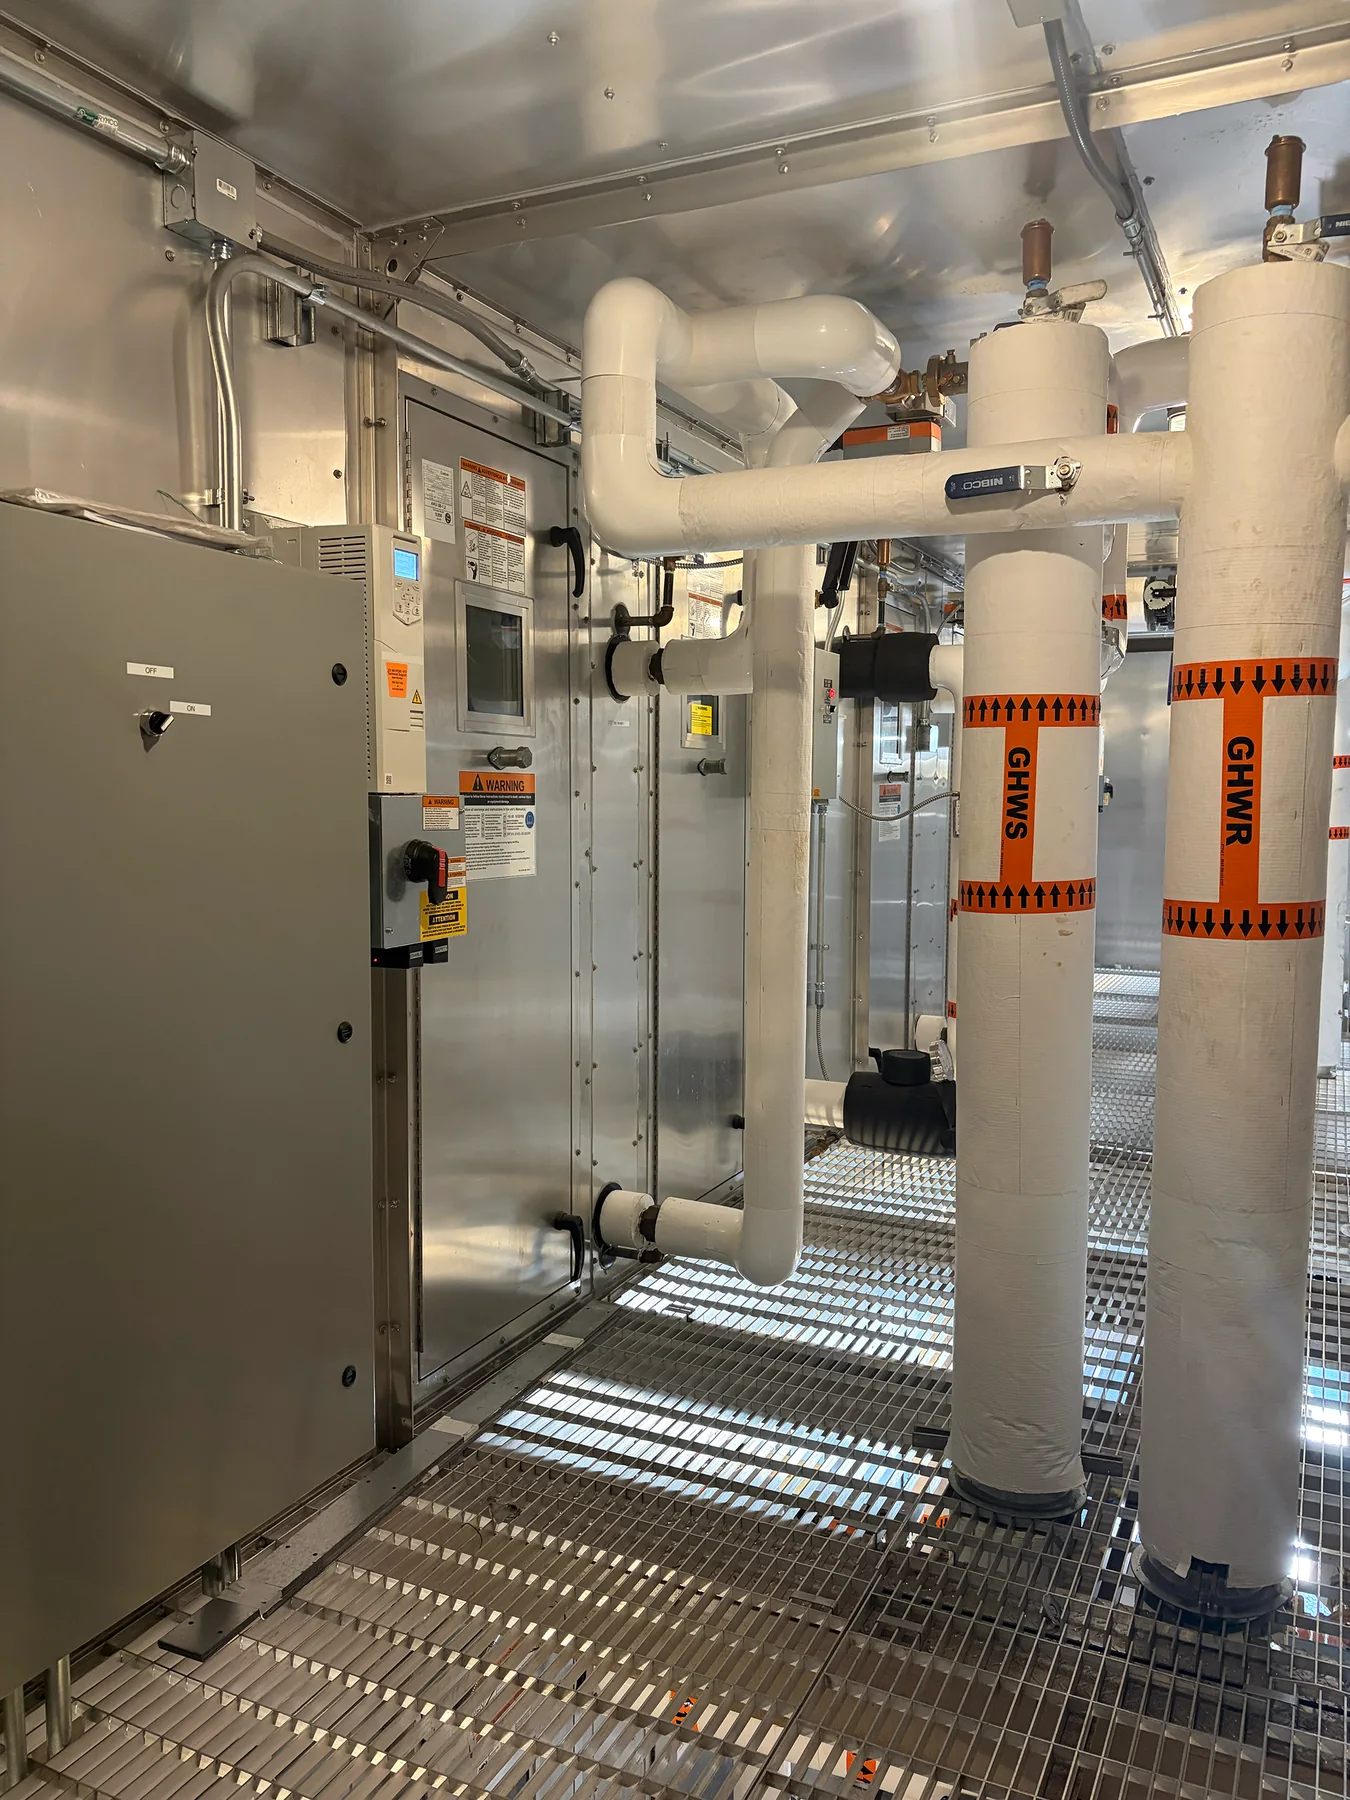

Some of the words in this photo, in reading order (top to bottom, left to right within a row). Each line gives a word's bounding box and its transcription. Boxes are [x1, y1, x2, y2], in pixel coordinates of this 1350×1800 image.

[963, 477, 1003, 490] NIBCO
[144, 666, 157, 674] OFF
[186, 704, 196, 712] ON
[486, 779, 525, 792] WARNING
[1225, 736, 1255, 846] GHWR
[1005, 746, 1031, 840] GHWS
[432, 914, 456, 923] ATTENTION
